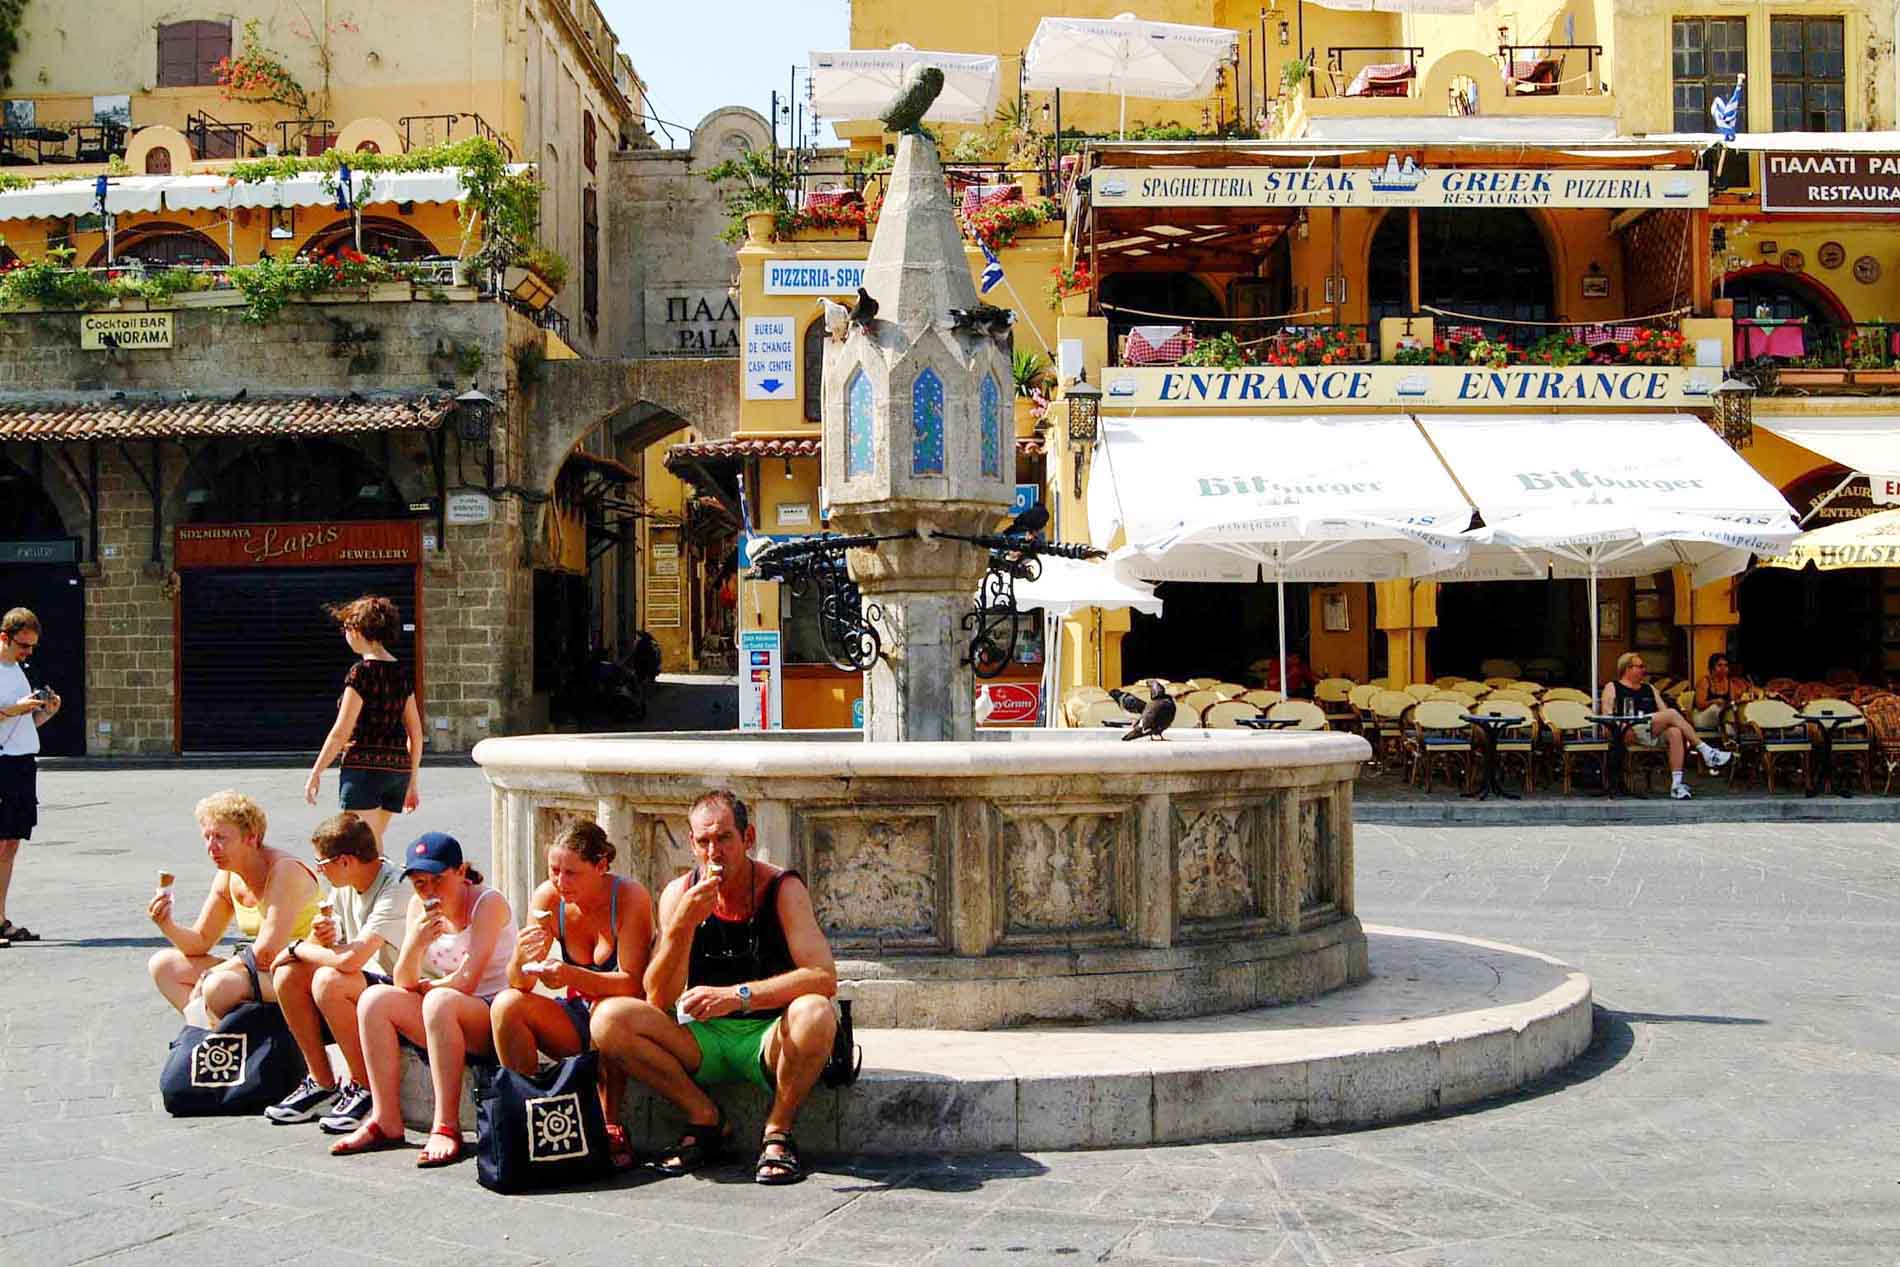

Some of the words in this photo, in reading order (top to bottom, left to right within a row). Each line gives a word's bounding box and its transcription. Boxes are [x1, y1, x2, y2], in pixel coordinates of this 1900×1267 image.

[1869, 158, 1900, 174] PA
[1141, 177, 1253, 197] SPAGHETTERIA
[1264, 171, 1358, 191] STEAK
[1441, 172, 1553, 192] GREEK
[1564, 179, 1652, 199] PIZZERIA
[1266, 192, 1356, 204] HOUSE
[1443, 193, 1551, 204] RESTAURANT
[85, 318, 137, 330] Cocktail
[140, 317, 167, 328] BAR
[754, 323, 785, 335] BUREAU
[98, 331, 169, 344] PANORAMA
[748, 342, 760, 353] DE
[762, 341, 792, 353] CHANGE
[748, 361, 766, 372] CASH
[769, 360, 792, 372] CENTRE
[1158, 372, 1373, 400] ENTRANCE
[1456, 371, 1669, 400] ENTRANCE
[244, 524, 338, 563] Lapis
[339, 549, 409, 560] JEWELLERY
